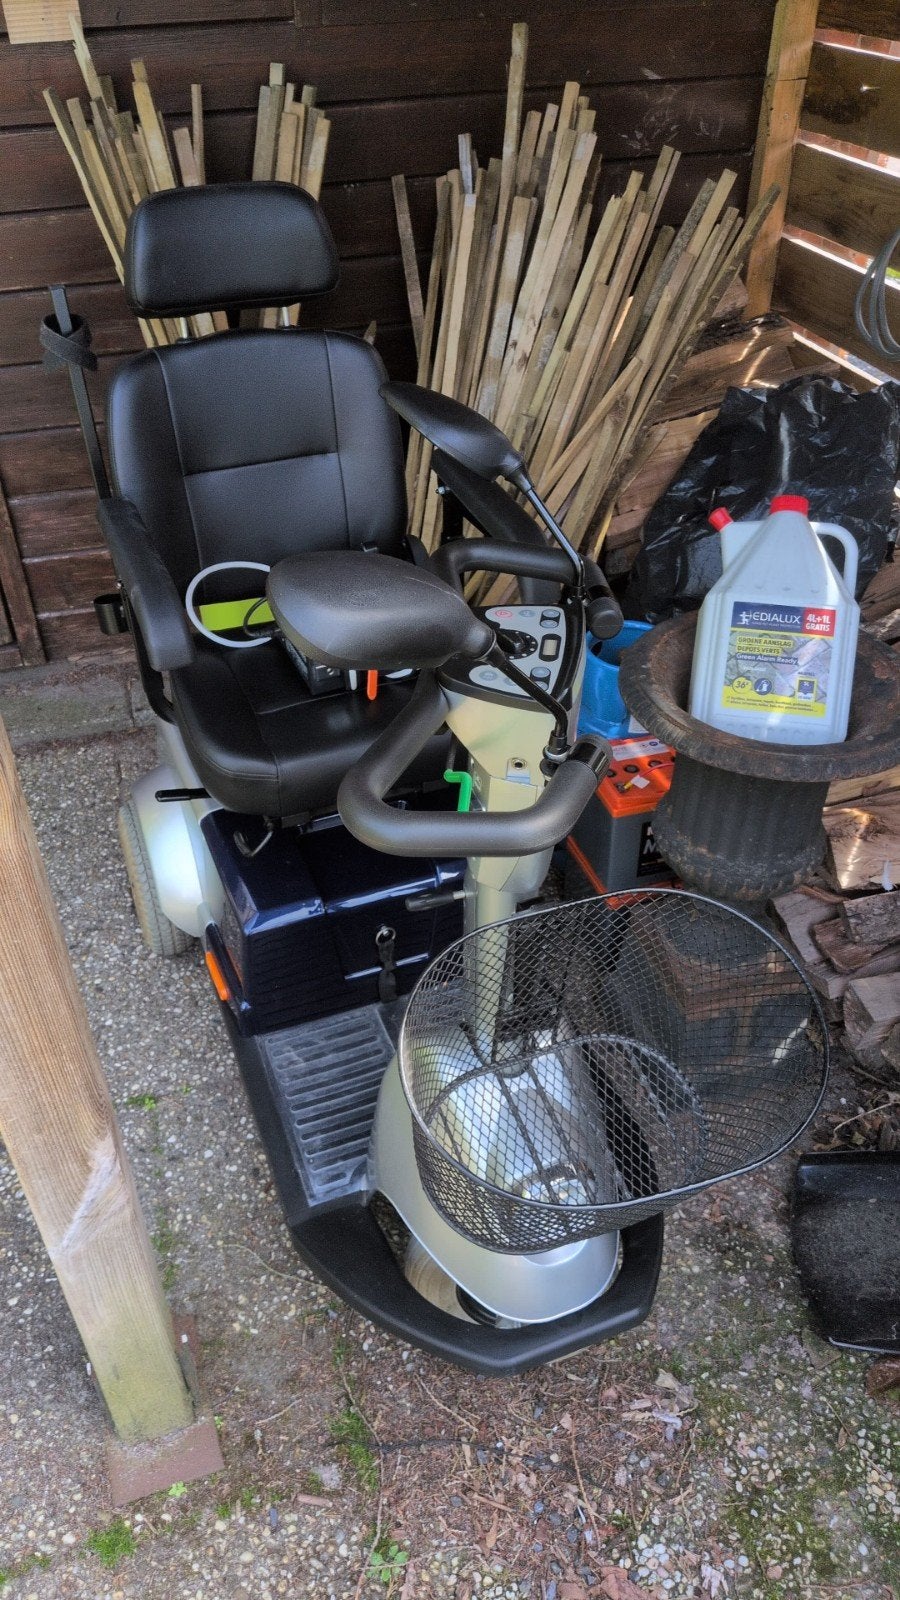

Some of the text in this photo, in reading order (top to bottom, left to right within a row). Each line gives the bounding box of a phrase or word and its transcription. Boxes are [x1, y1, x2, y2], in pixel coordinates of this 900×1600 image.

[752, 611, 802, 625] EDIALUX
[806, 613, 831, 624] 4L+1L
[805, 623, 831, 632] GRATIS
[738, 636, 792, 647] GROENE AANSLAG
[736, 653, 799, 665] Green Alarm Ready
